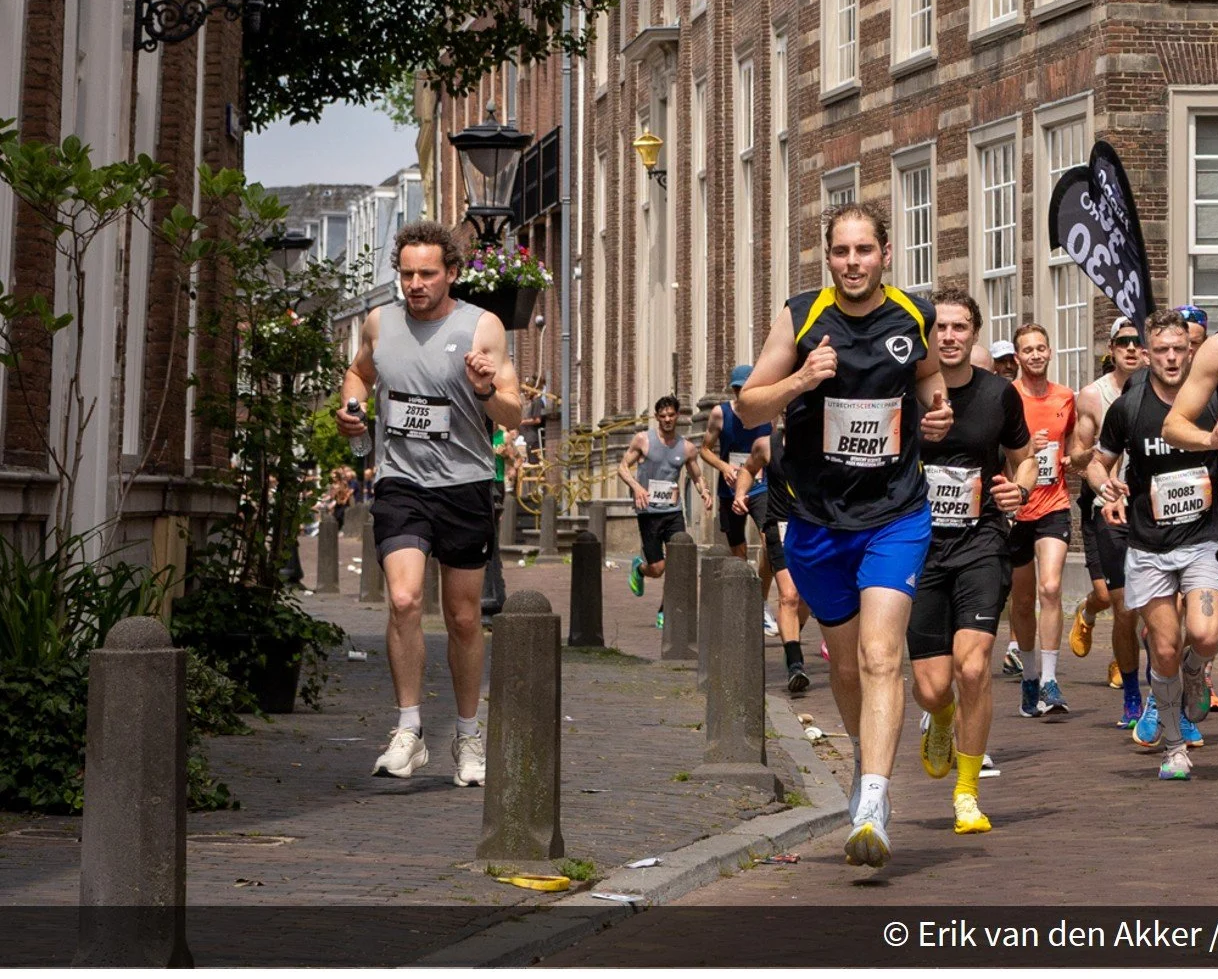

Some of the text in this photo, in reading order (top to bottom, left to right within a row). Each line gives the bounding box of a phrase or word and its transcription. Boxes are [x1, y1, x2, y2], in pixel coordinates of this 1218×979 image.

[405, 405, 430, 417] 28735
[403, 416, 431, 429] JAAP
[850, 421, 879, 434] 12171
[837, 435, 889, 454] BERRY
[936, 485, 961, 498] 11211
[1167, 485, 1195, 499] 10083
[1163, 499, 1203, 515] ROLAND
